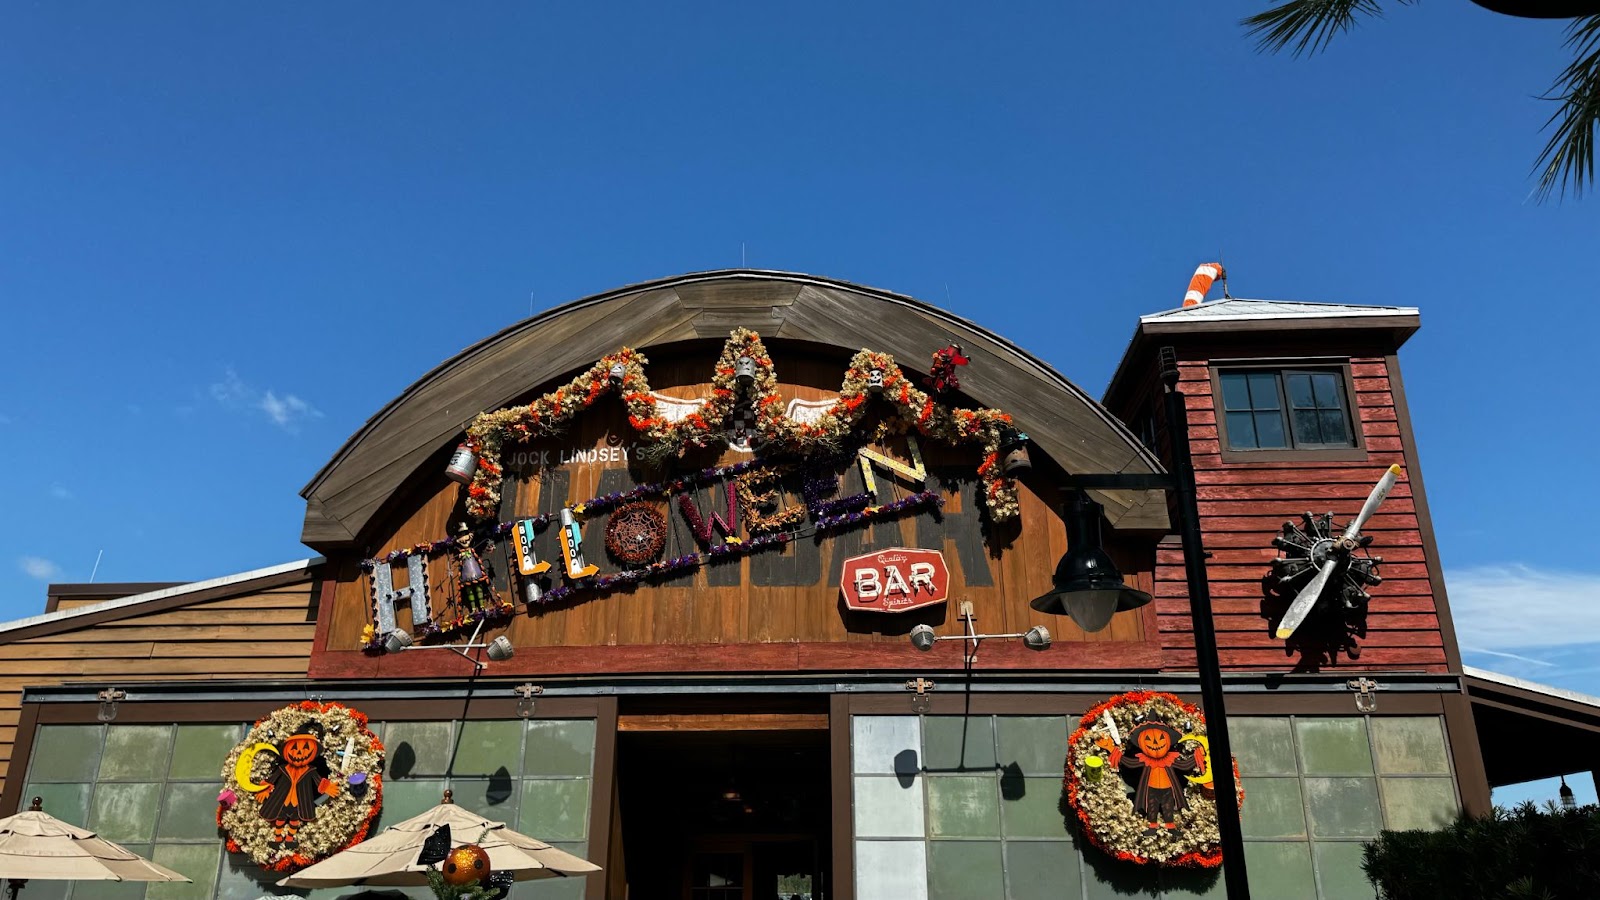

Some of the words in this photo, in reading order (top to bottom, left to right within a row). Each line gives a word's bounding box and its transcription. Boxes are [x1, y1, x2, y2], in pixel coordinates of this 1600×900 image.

[506, 450, 550, 466] JOCK
[560, 442, 647, 464] LINDSEY'S
[519, 526, 529, 555] BOO
[566, 528, 576, 558] BOO
[877, 553, 908, 565] Quality
[855, 562, 938, 598] BAR
[882, 596, 914, 609] Spirits
